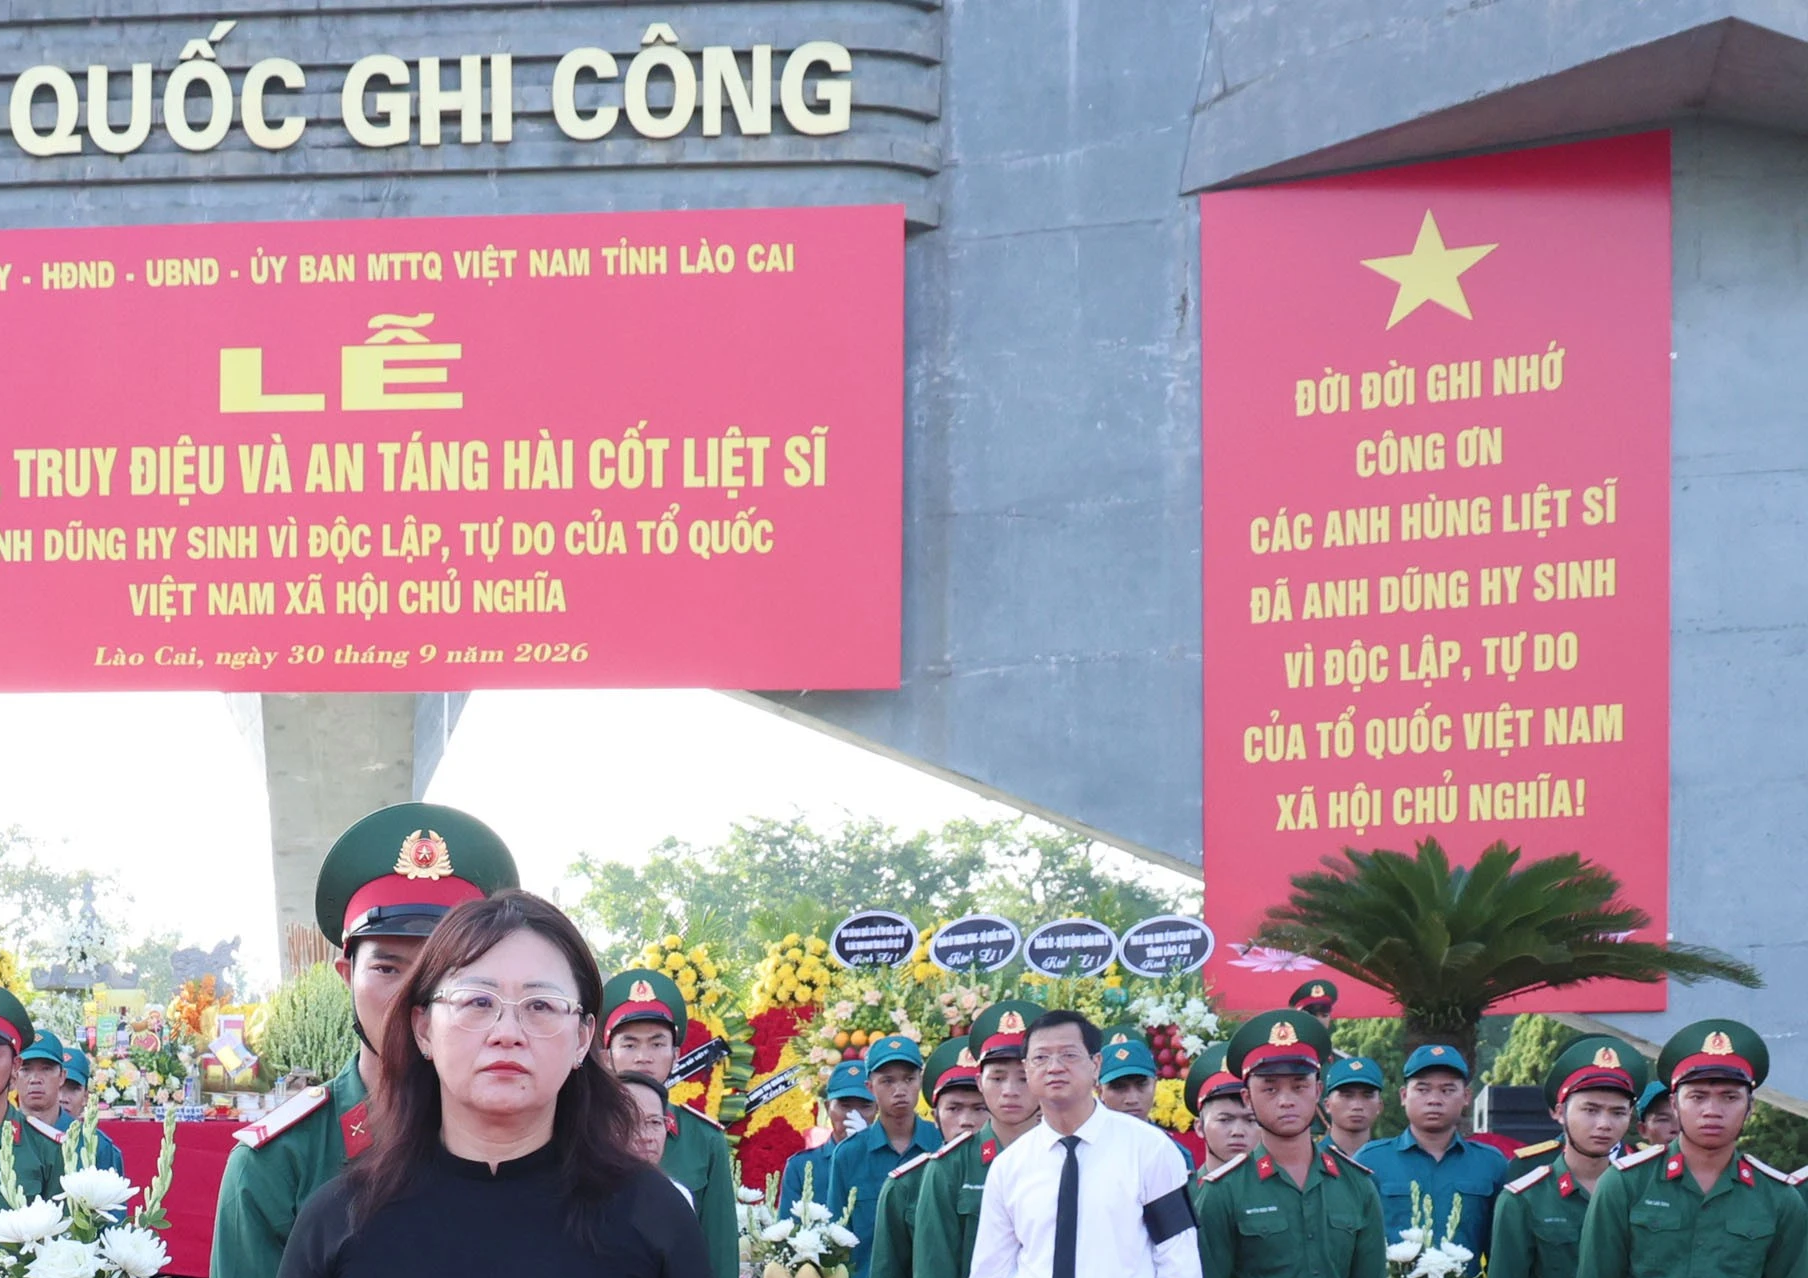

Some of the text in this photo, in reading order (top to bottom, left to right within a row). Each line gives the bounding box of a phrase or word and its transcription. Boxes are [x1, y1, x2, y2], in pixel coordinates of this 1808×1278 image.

[8, 20, 307, 158] QUỐC
[340, 52, 514, 148] GHI
[550, 22, 854, 141] CÔNG
[42, 260, 116, 289] HĐND
[146, 257, 220, 286] UBND
[250, 248, 287, 284] ỦY
[299, 255, 356, 283] BAN
[368, 251, 443, 281] MTTQ
[453, 244, 518, 285] VIỆT
[529, 248, 591, 277] NAM
[602, 239, 668, 275] TỈNH
[680, 239, 736, 274] LÀO
[747, 243, 795, 272] CAI
[219, 311, 464, 413] LỄ
[1296, 340, 1565, 416] ĐỜI ĐỜI GHI NHỚ
[13, 446, 118, 497] TRUY
[129, 433, 226, 505] ĐIỆU
[238, 432, 293, 494] VÀ
[305, 442, 365, 493] AN
[377, 430, 489, 491] TÁNG
[504, 427, 574, 490] HÀI
[589, 421, 670, 489] CỐT
[683, 425, 771, 497] LIỆT
[784, 425, 829, 487] SĨ
[1356, 426, 1503, 477] CÔNG ƠN
[44, 521, 127, 561] DŨNG
[136, 527, 177, 560] HY
[187, 526, 258, 559] SINH
[268, 517, 298, 558] VÌ
[308, 516, 372, 562] ĐỘC
[382, 515, 450, 562] LẬP,
[460, 516, 504, 561] TỰ
[512, 521, 555, 556] DO
[565, 509, 627, 555] CỦA
[636, 503, 680, 554] TỔ
[688, 507, 774, 559] QUỐC
[1251, 478, 1616, 554] CÁC ANH HÙNG LIỆT SĨ
[129, 568, 567, 622] VIỆT NAM XÃ HỘI CHỦ NGHĨA
[1250, 558, 1616, 624] ĐÃ ANH DŨNG HY SINH
[96, 643, 589, 669] Lào Cai, ngày 30 tháng 9 năm 2026
[1284, 631, 1578, 692] VÌ ĐỘC LẬP, TỰ DO
[1244, 702, 1623, 763] CỦA TỔ QUỐC VIỆT NAM
[1276, 770, 1585, 835] XÃ HỘI CHỦ NGHĨA!
